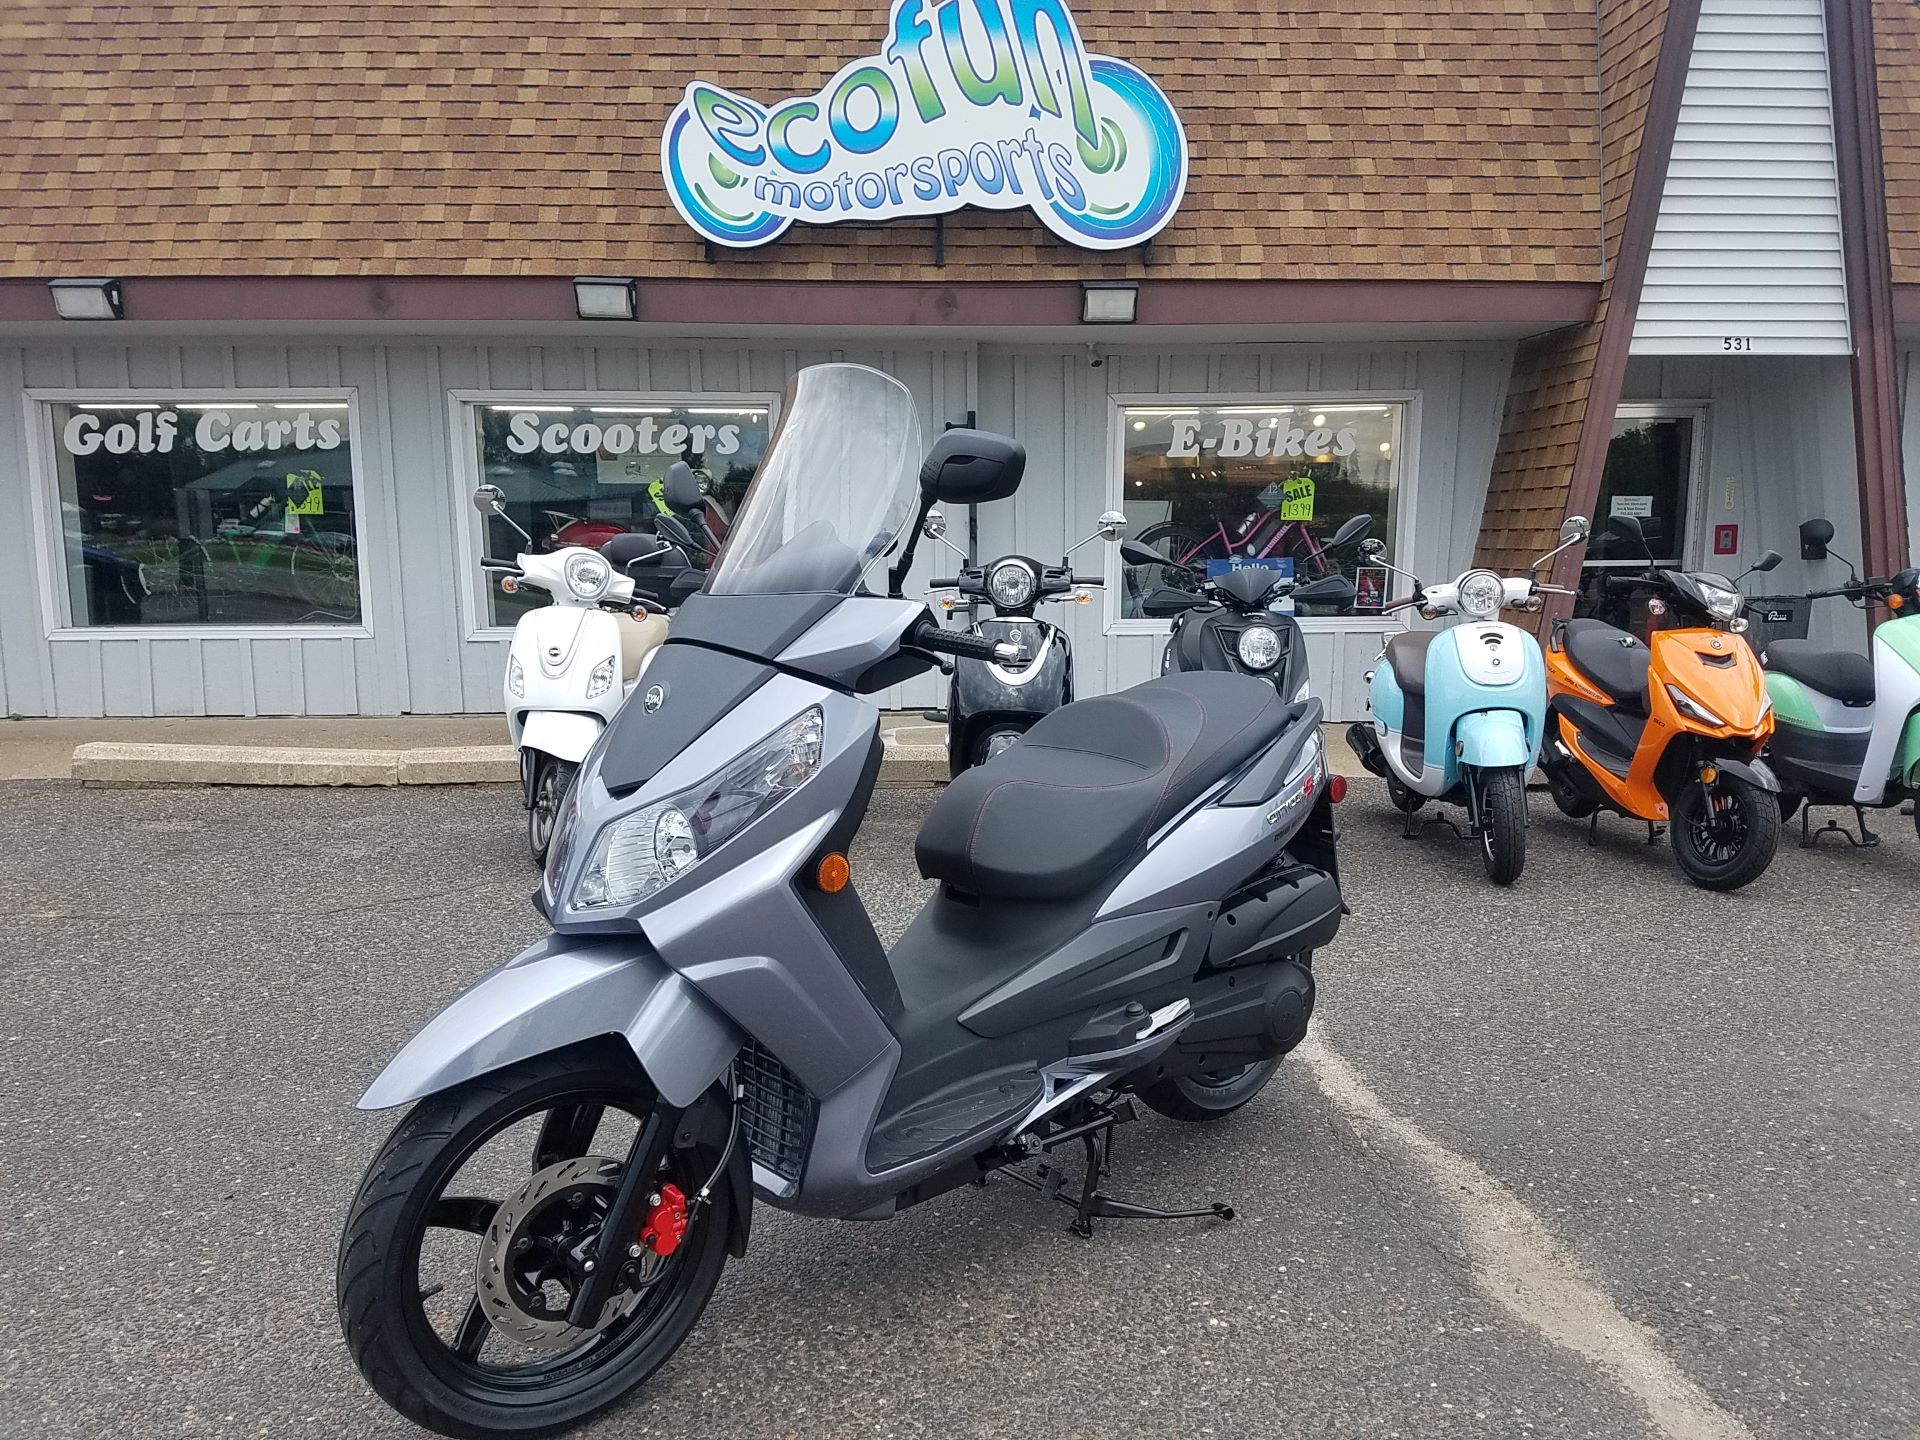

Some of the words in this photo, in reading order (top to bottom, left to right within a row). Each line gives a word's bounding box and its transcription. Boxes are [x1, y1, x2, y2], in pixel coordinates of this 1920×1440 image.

[753, 127, 1087, 212] motorsports
[1723, 336, 1752, 351] 531
[63, 411, 178, 456] Golf
[195, 411, 341, 453] Carts
[506, 413, 741, 455] Scooters
[1166, 418, 1358, 458] E-Bikes
[1285, 484, 1312, 503] SALE
